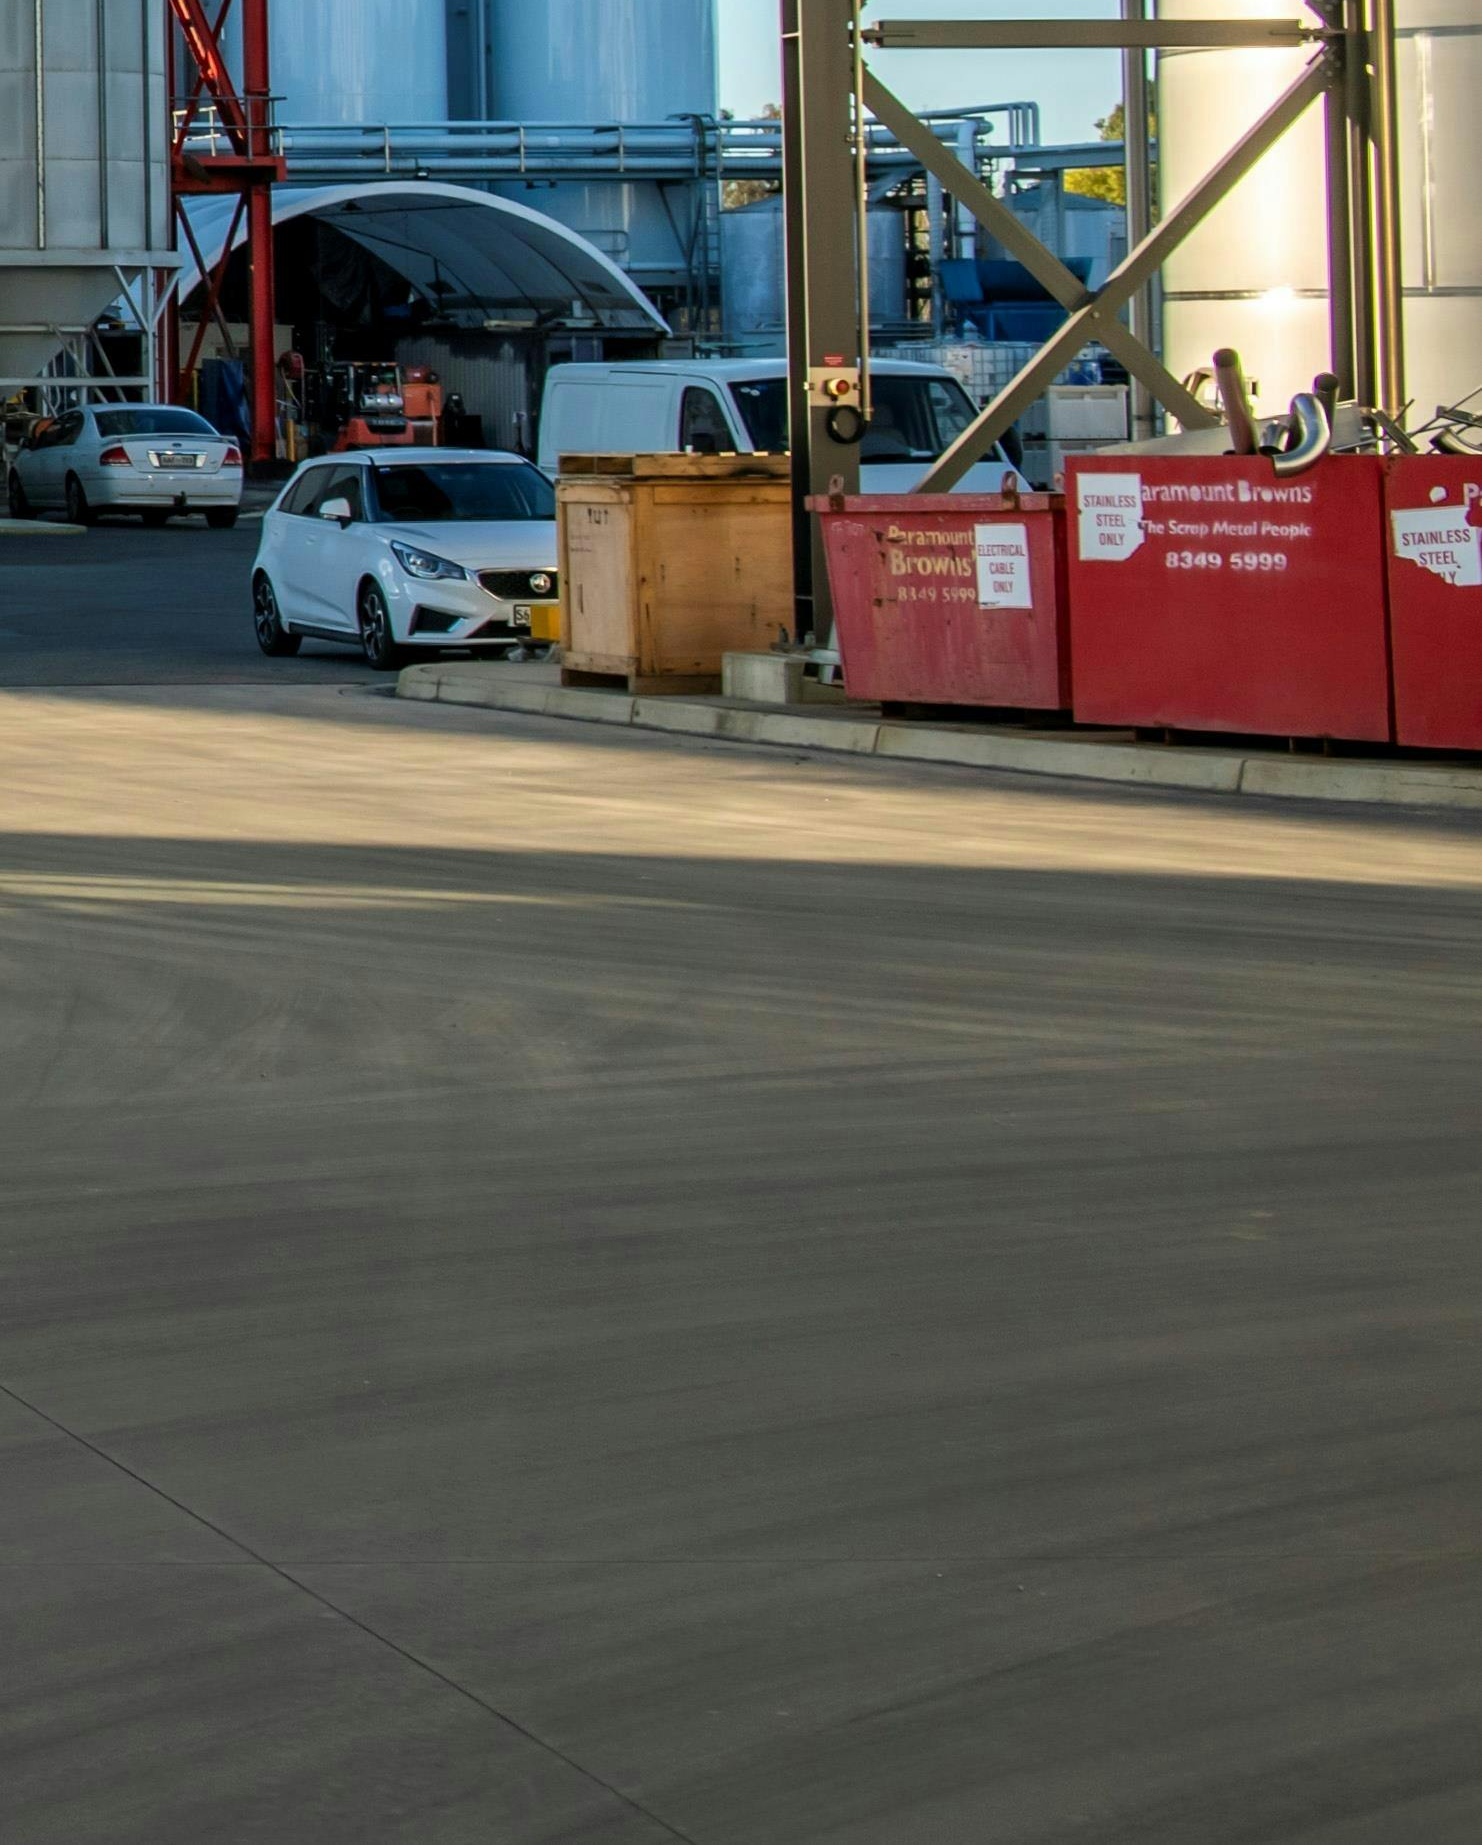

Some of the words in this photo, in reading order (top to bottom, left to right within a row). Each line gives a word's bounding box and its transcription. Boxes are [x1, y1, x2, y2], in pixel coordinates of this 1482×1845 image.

[1140, 483, 1235, 502] aramount
[1083, 495, 1137, 508] STAINLESS
[1095, 514, 1126, 528] STEEL
[1212, 521, 1257, 537] Metal
[1260, 521, 1313, 541] People
[1401, 529, 1472, 547] STAINLESS
[1099, 533, 1125, 546] ONLY
[977, 544, 1025, 557] ELECTRICAL
[1419, 550, 1459, 566] STEEL
[988, 562, 1015, 575] CABLE
[1164, 551, 1223, 570] 8349
[1229, 552, 1288, 571] 5999
[897, 586, 937, 603] 8349
[992, 581, 1014, 594] ONLY
